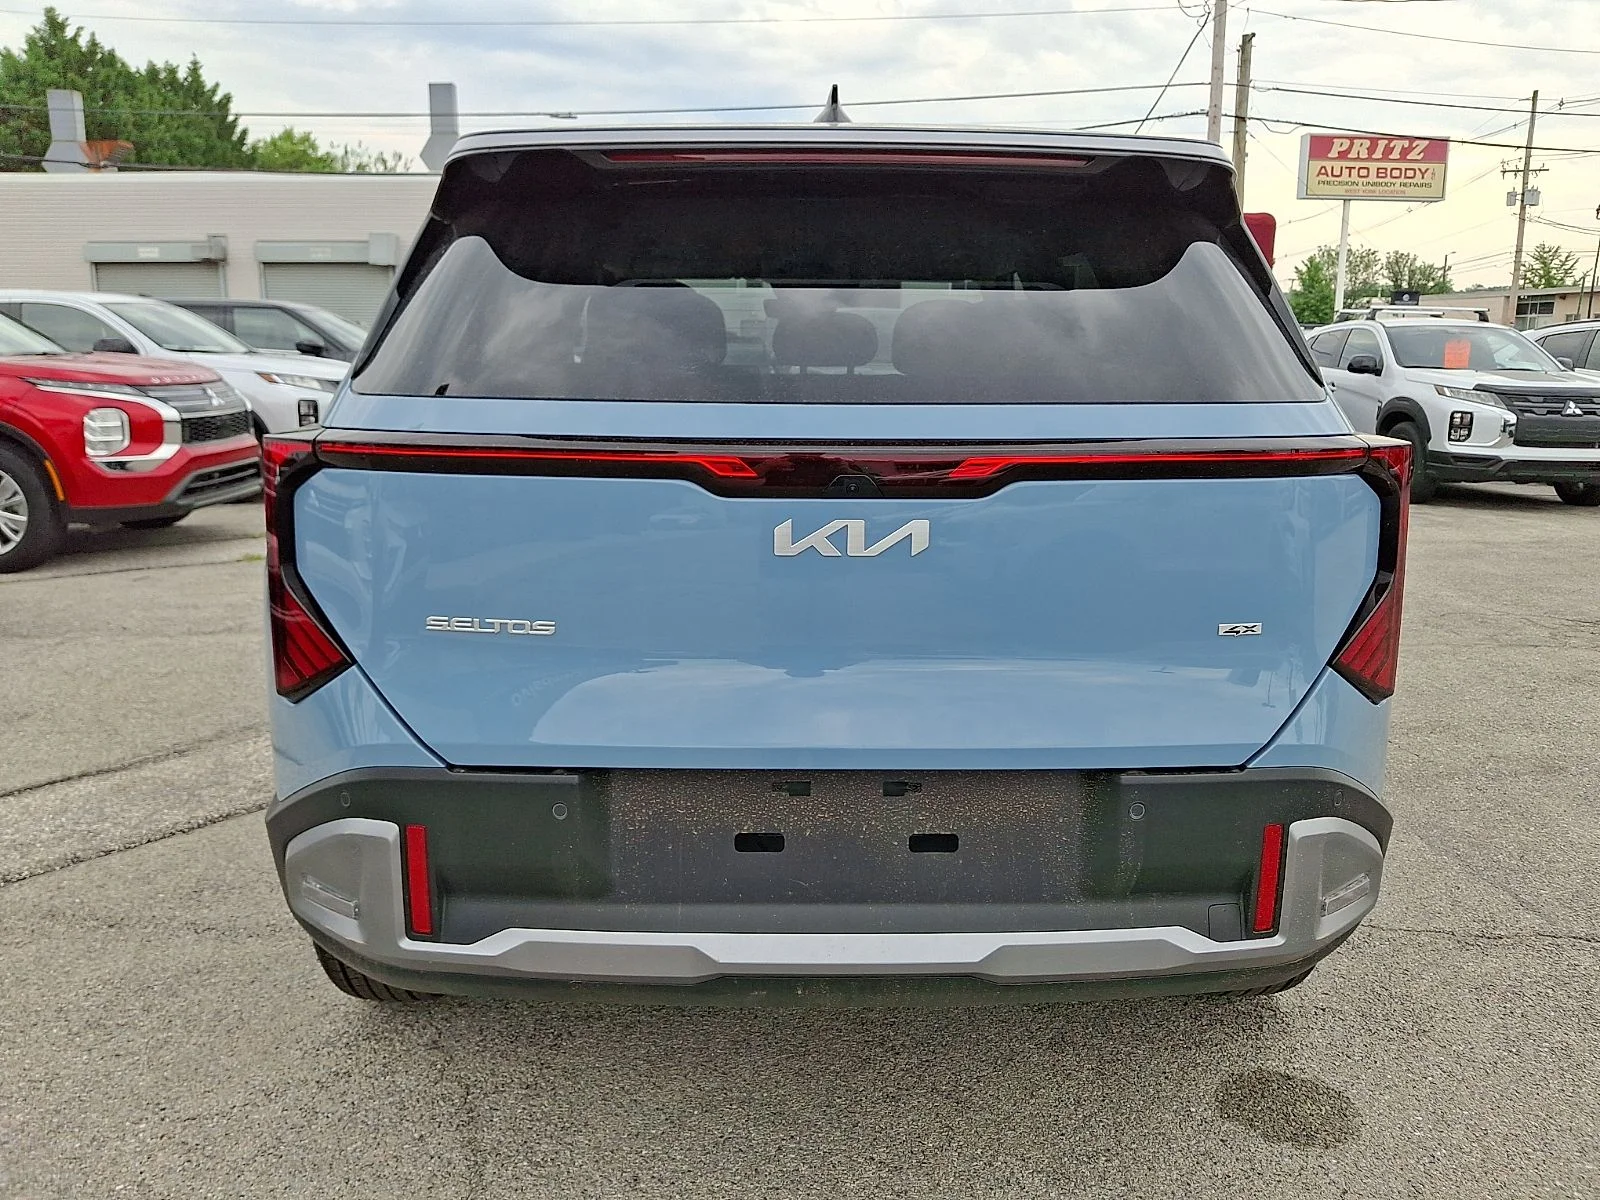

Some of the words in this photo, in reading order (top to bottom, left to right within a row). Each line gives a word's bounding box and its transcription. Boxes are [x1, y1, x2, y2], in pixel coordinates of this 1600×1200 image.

[1328, 138, 1429, 160] PRITZ
[1316, 165, 1370, 179] AUTO
[1376, 167, 1429, 180] BODY
[1317, 179, 1359, 187] PRECISION
[1362, 180, 1397, 188] UNIBODY
[1399, 181, 1433, 189] REPAIRS
[774, 518, 930, 557] KIA
[425, 615, 557, 636] SELTOS
